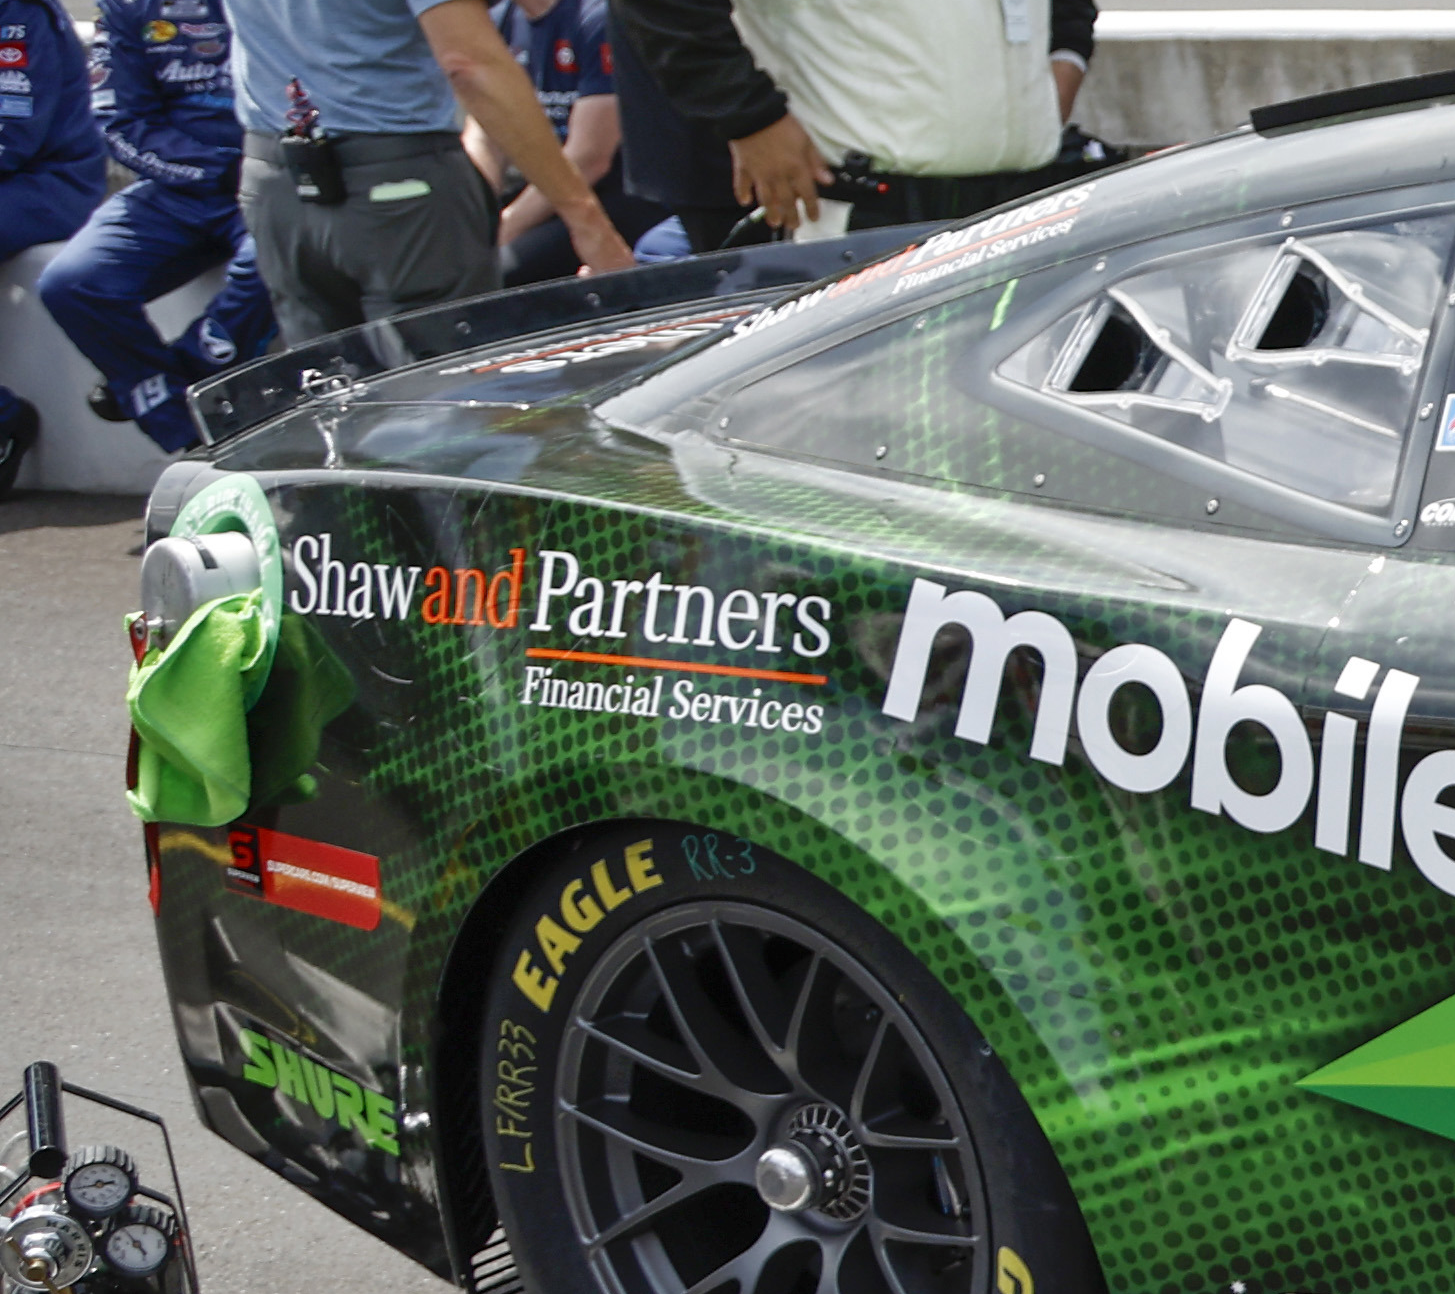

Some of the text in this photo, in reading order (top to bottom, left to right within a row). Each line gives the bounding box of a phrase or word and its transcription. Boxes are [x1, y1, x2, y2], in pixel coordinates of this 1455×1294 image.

[892, 215, 1075, 295] Financial Services
[905, 181, 1098, 269] Partners
[529, 550, 831, 658] Partners
[521, 666, 824, 735] Financial Services
[680, 833, 756, 882] RR-3
[511, 838, 664, 1013] EAGLE
[238, 1027, 400, 1157] SHURE
